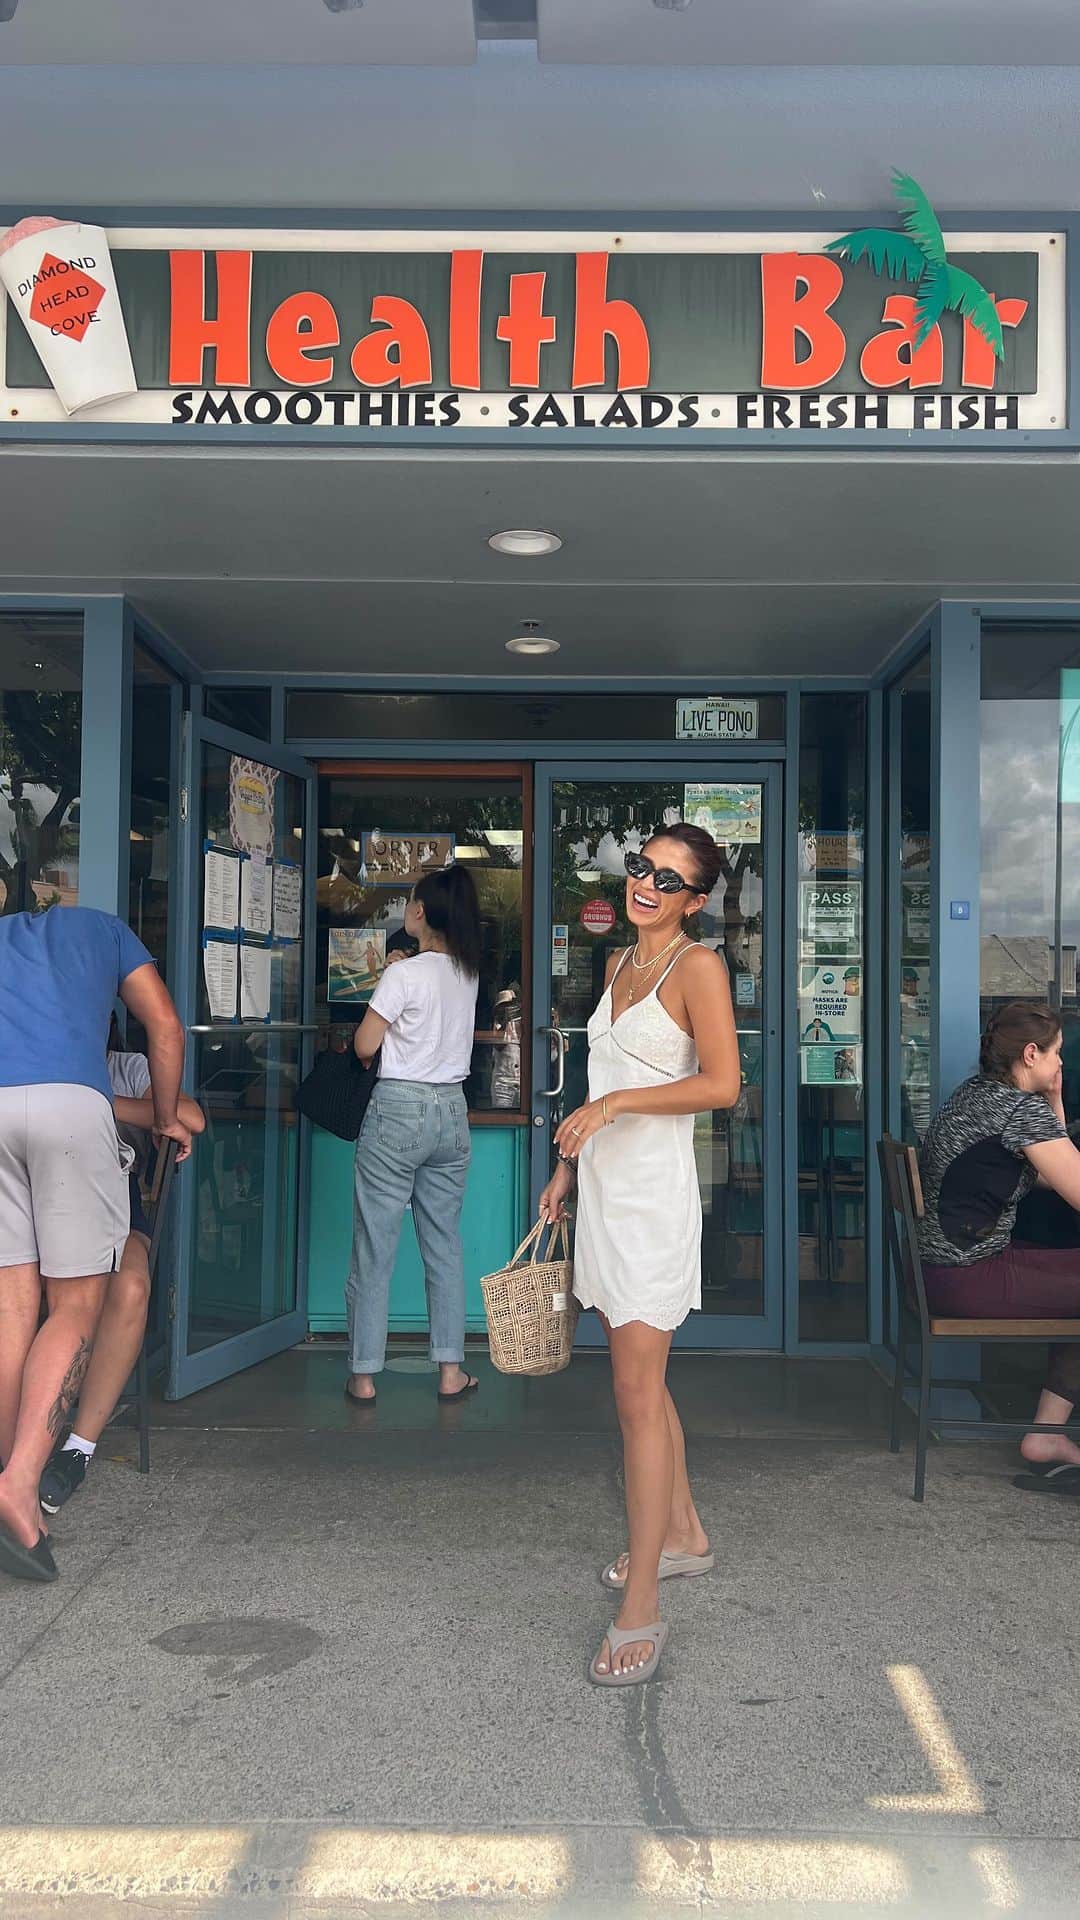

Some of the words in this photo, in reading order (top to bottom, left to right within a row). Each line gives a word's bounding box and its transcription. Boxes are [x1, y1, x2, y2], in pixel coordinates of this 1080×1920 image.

[18, 257, 96, 297] DIAMOND
[40, 286, 89, 313] HEAD
[50, 310, 100, 336] COVE
[168, 249, 650, 391] Health
[760, 252, 1028, 391] Bar
[172, 391, 460, 426] SMOOTHIES
[508, 393, 699, 428] SALADS
[736, 394, 888, 429] FRESH
[913, 395, 1019, 430] FISH
[682, 710, 713, 731] LIVE
[718, 710, 753, 732] PONO
[374, 840, 439, 857] ORDER
[810, 892, 852, 905] PASS
